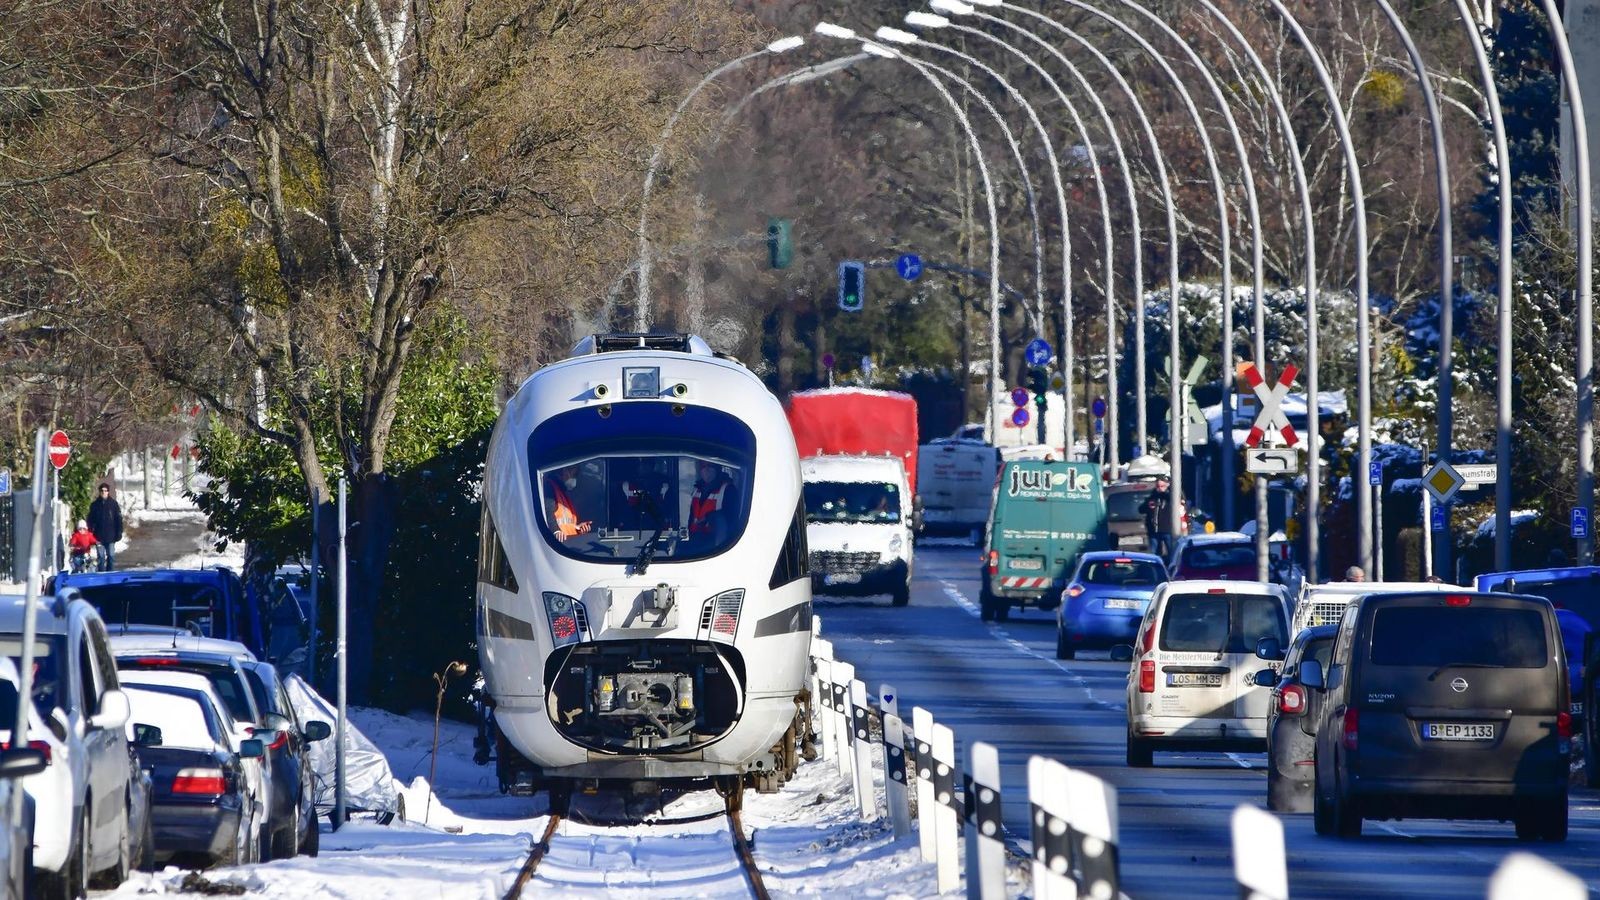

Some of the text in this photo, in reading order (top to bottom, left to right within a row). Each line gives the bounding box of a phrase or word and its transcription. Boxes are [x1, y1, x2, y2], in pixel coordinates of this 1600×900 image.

[1461, 468, 1496, 479] aumstraß
[1009, 465, 1093, 497] jurk
[1172, 675, 1221, 684] LOS MM 35
[1430, 725, 1493, 737] B EP 1133
